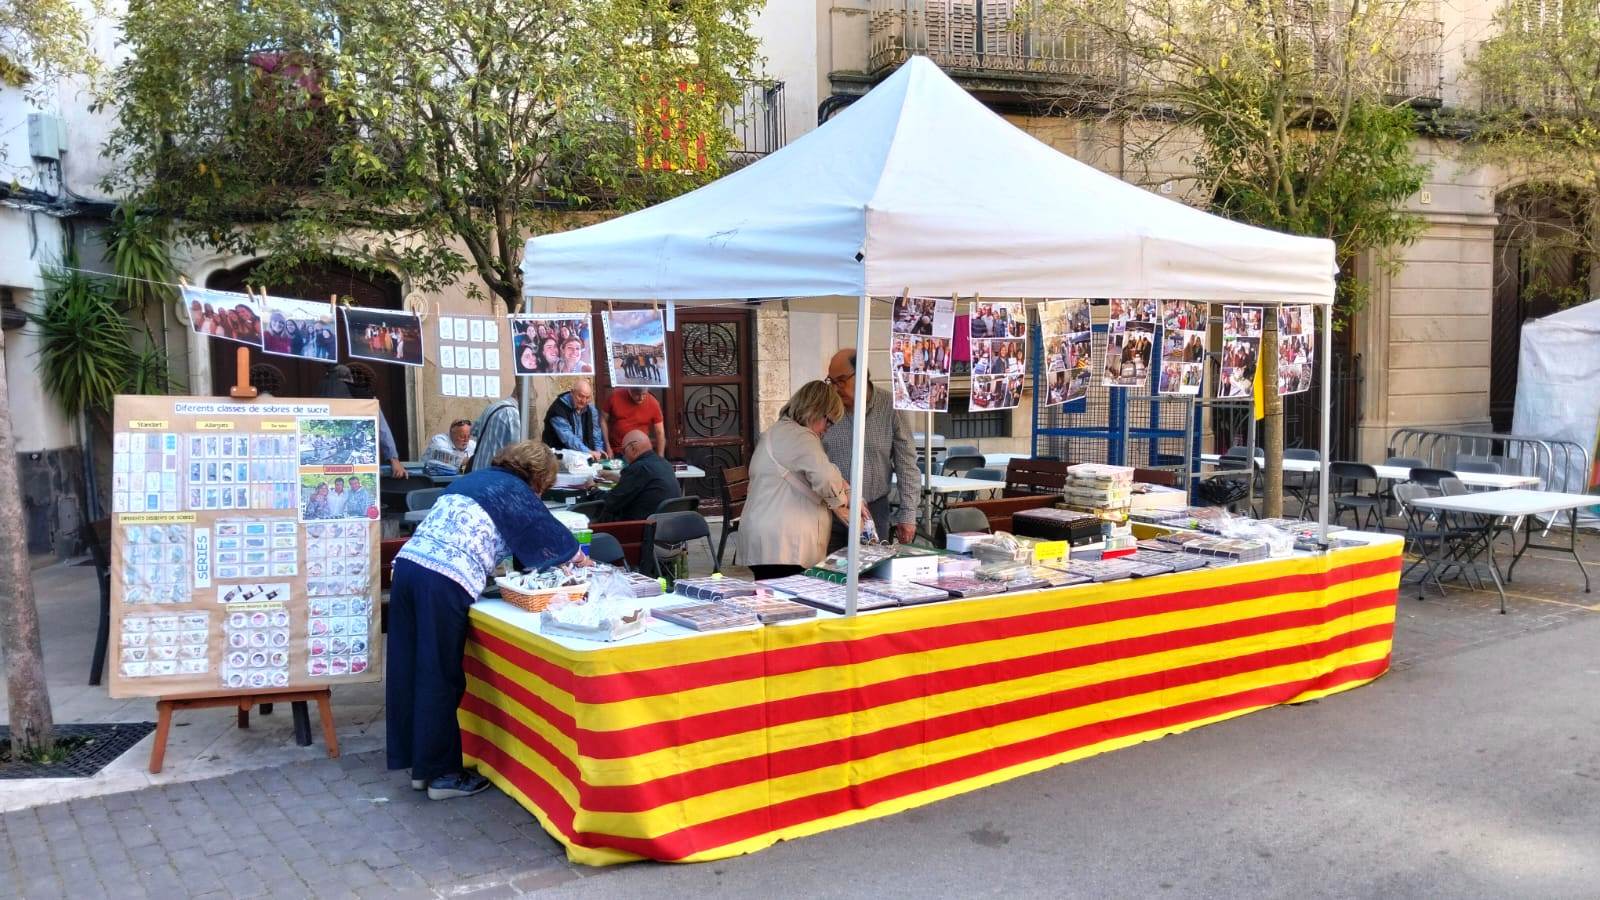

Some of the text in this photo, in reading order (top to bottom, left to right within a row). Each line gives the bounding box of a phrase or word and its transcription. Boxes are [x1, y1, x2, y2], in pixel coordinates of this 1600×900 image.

[175, 403, 329, 415] Diferents classes de sobres de sucre
[196, 535, 208, 580] SERIES
